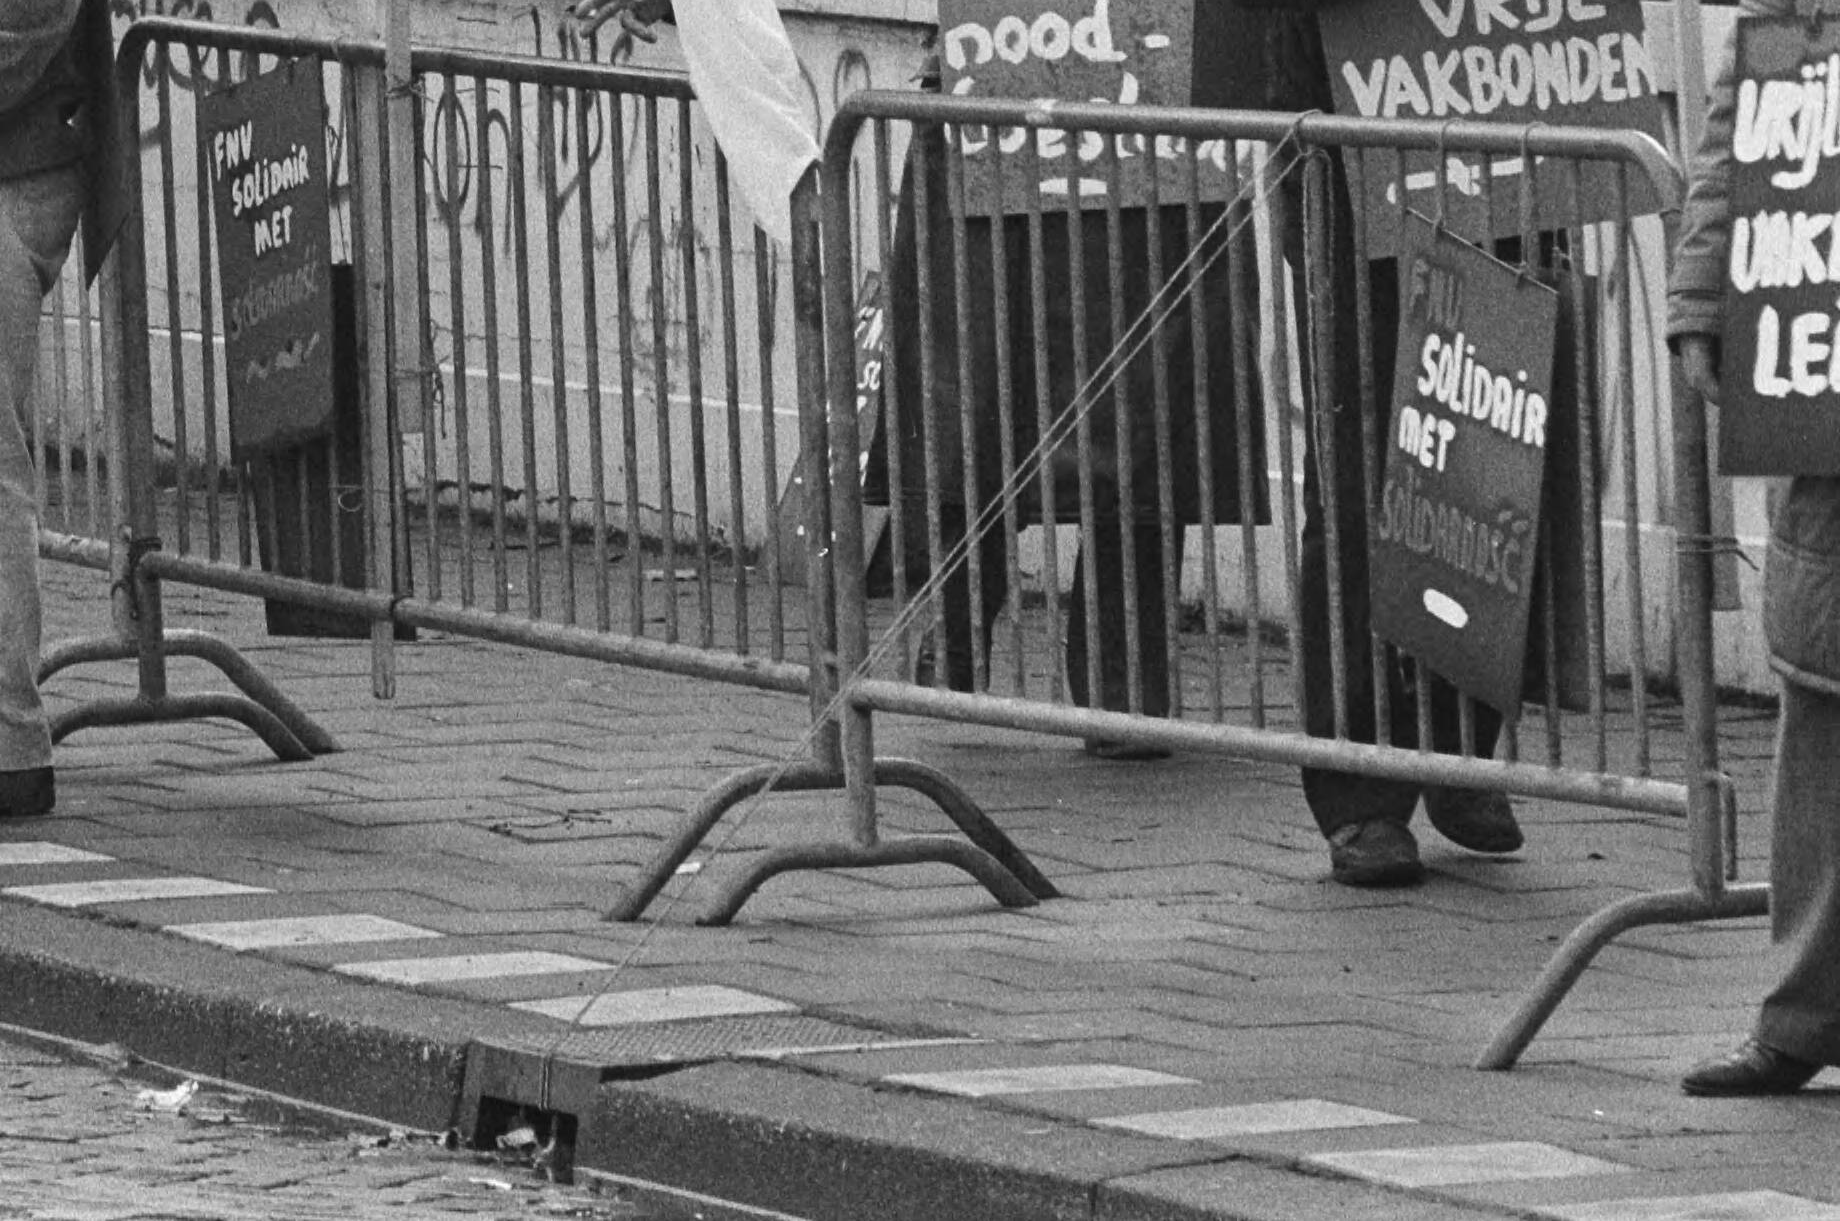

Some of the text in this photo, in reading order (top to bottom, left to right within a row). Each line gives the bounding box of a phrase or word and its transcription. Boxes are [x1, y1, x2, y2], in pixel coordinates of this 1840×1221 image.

[1343, 33, 1658, 117] VAKBONDEN
[213, 119, 254, 182] FNV
[254, 205, 294, 259] MET
[1397, 405, 1457, 473] MET
